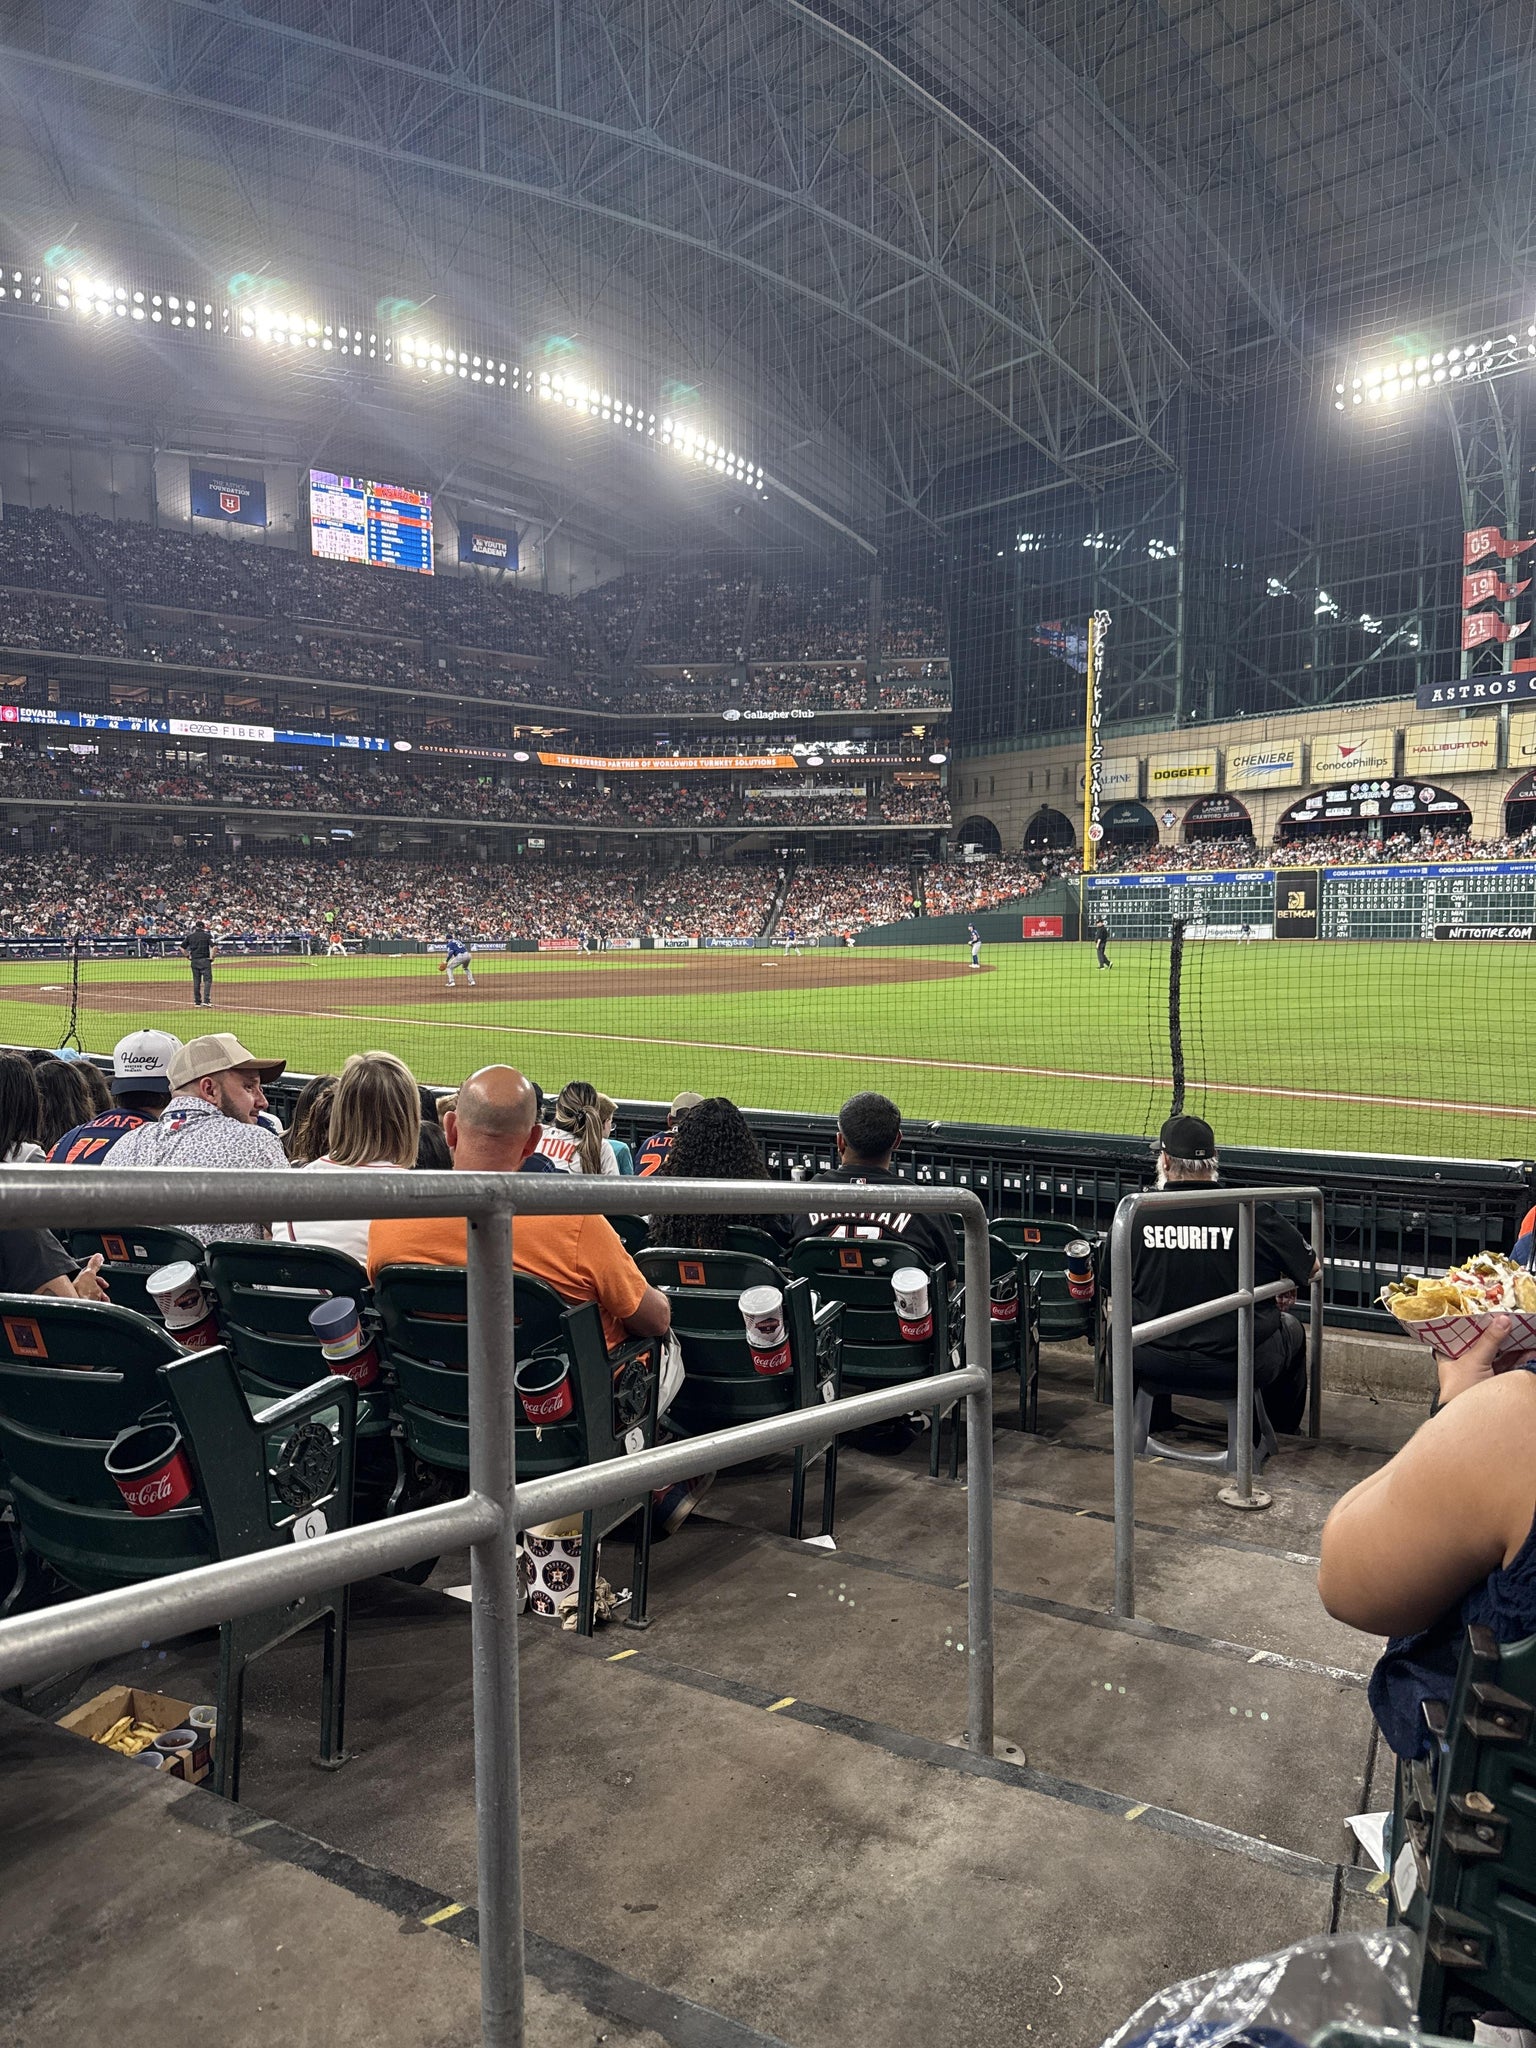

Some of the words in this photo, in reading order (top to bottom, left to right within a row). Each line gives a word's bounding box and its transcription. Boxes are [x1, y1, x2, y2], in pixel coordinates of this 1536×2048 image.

[209, 484, 250, 496] FOUNDATION
[1471, 533, 1490, 554] 05
[472, 545, 507, 557] ACADEMY
[1471, 578, 1489, 597] 19
[1468, 620, 1486, 638] 21
[1431, 679, 1517, 703] ASTROS
[20, 708, 57, 717] EOVALDI
[743, 710, 790, 720] Gallagher
[791, 709, 815, 718] Club
[86, 719, 96, 727] 27
[148, 718, 159, 733] K
[190, 723, 218, 735] ezee
[223, 726, 265, 739] FIBER
[1412, 740, 1488, 754] HALLIBURTON
[557, 756, 570, 764] THE
[571, 758, 606, 767] PREFERRED
[607, 760, 636, 768] PARTNER
[700, 759, 732, 767] TURNKEY
[734, 758, 776, 766] SOLUTIONS
[1233, 752, 1295, 767] CHENIERE
[1316, 757, 1388, 771] ConocoPhillips
[1154, 766, 1210, 780] DOGGETT
[1091, 765, 1103, 822] FAIR
[1235, 873, 1265, 881] GEICO
[1277, 910, 1316, 919] BETMGM
[1449, 927, 1533, 939] NITTOTIRE.COM
[710, 937, 749, 947] AmegyBank
[121, 1051, 164, 1070] Hooey
[1143, 1225, 1234, 1250] SECURITY
[753, 1350, 787, 1368] Coca-Cola
[630, 1432, 637, 1450] 5
[305, 1516, 316, 1539] 6
